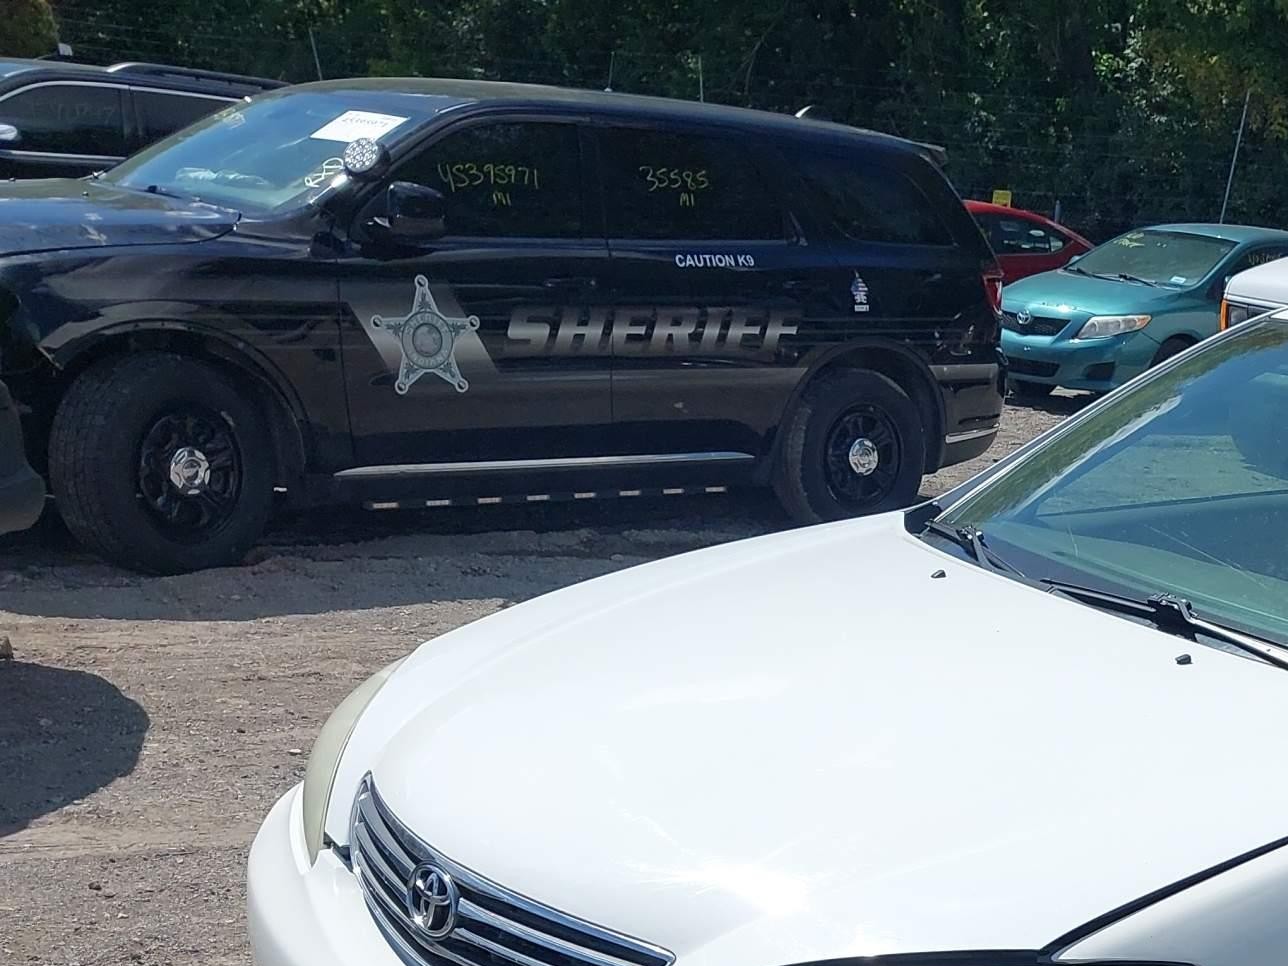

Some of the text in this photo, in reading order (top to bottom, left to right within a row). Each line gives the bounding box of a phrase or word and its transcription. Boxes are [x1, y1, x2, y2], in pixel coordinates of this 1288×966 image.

[438, 163, 539, 193] 45395971
[639, 166, 709, 191] 35585
[680, 192, 695, 206] MI
[675, 254, 755, 268] CAUTION K9
[507, 306, 799, 349] SHERIFF
